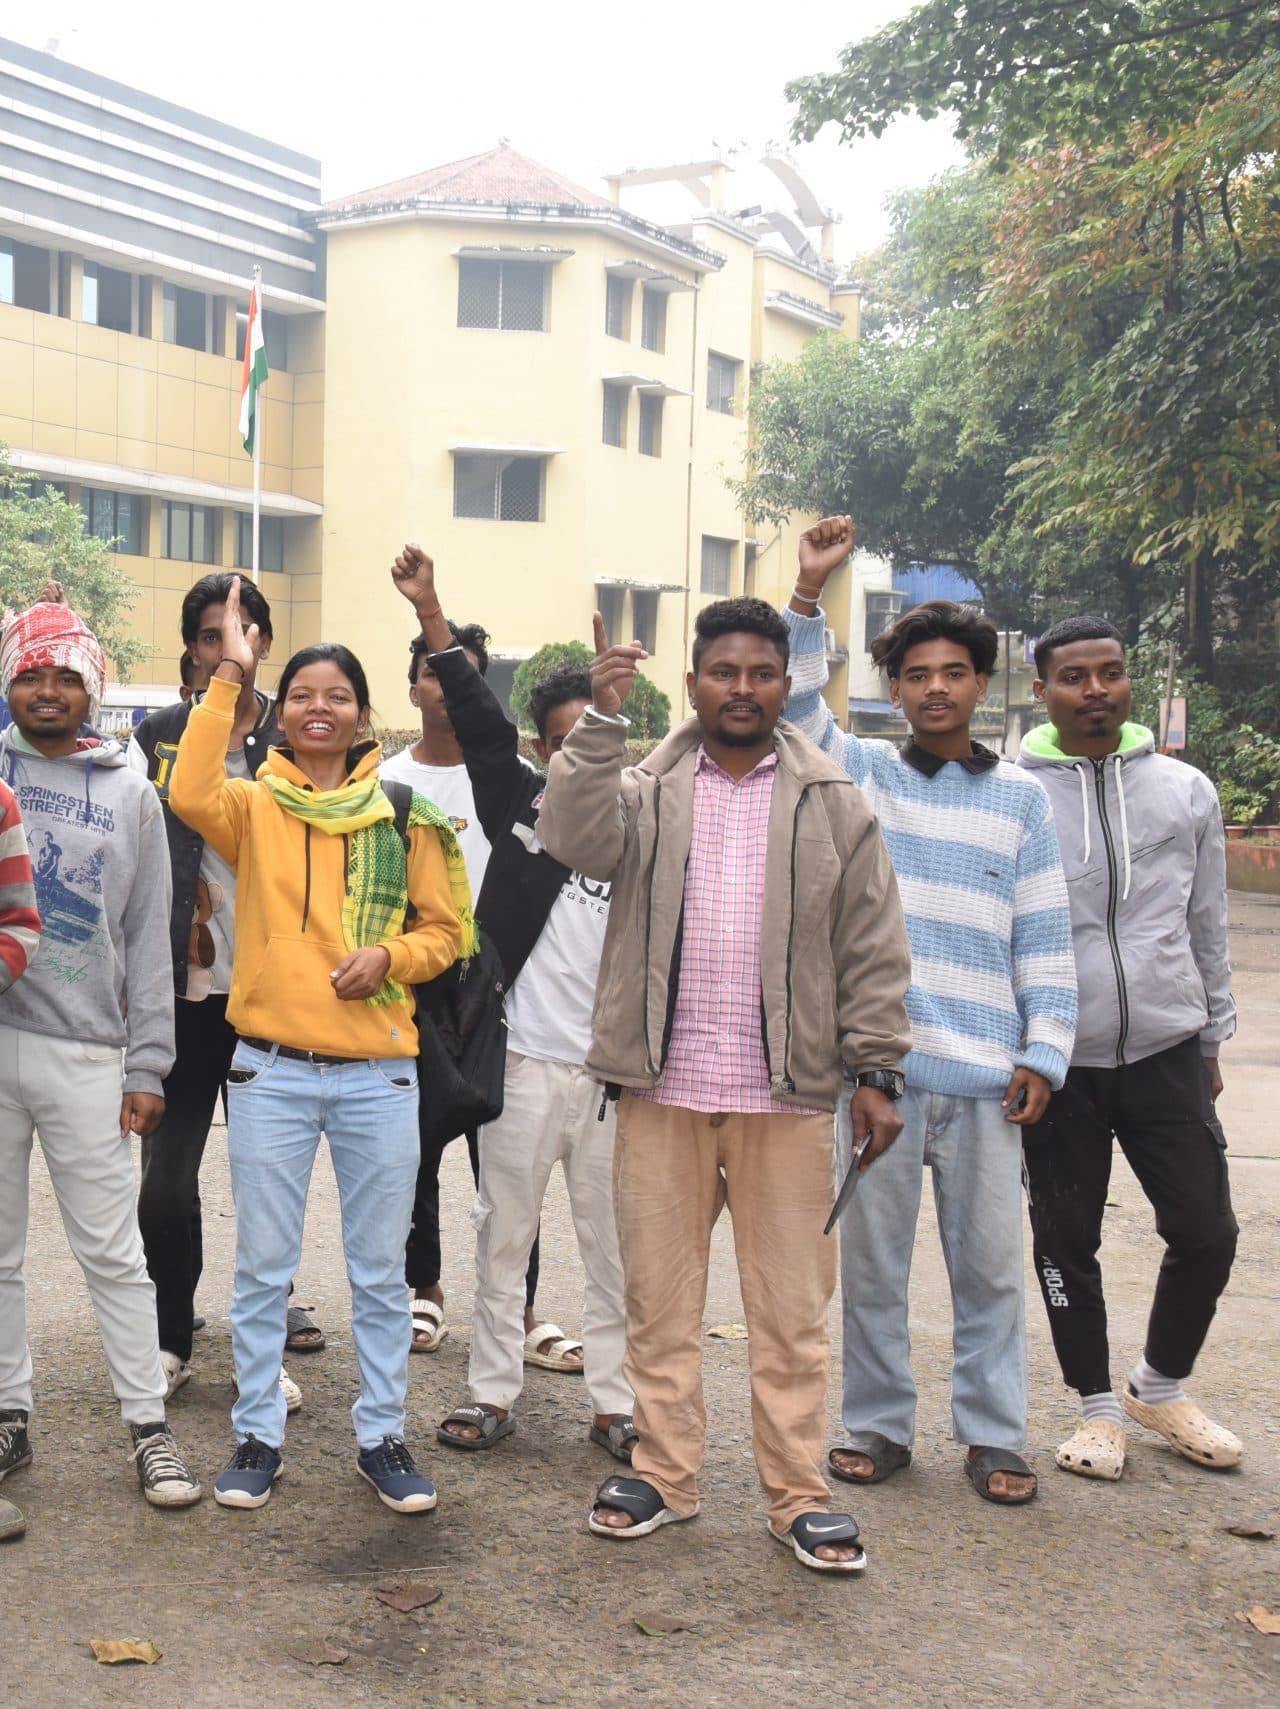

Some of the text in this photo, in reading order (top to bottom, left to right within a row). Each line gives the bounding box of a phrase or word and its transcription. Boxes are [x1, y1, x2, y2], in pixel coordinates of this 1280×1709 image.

[20, 786, 114, 820] SPRINGSTEEN
[20, 799, 115, 832] STREET BAND
